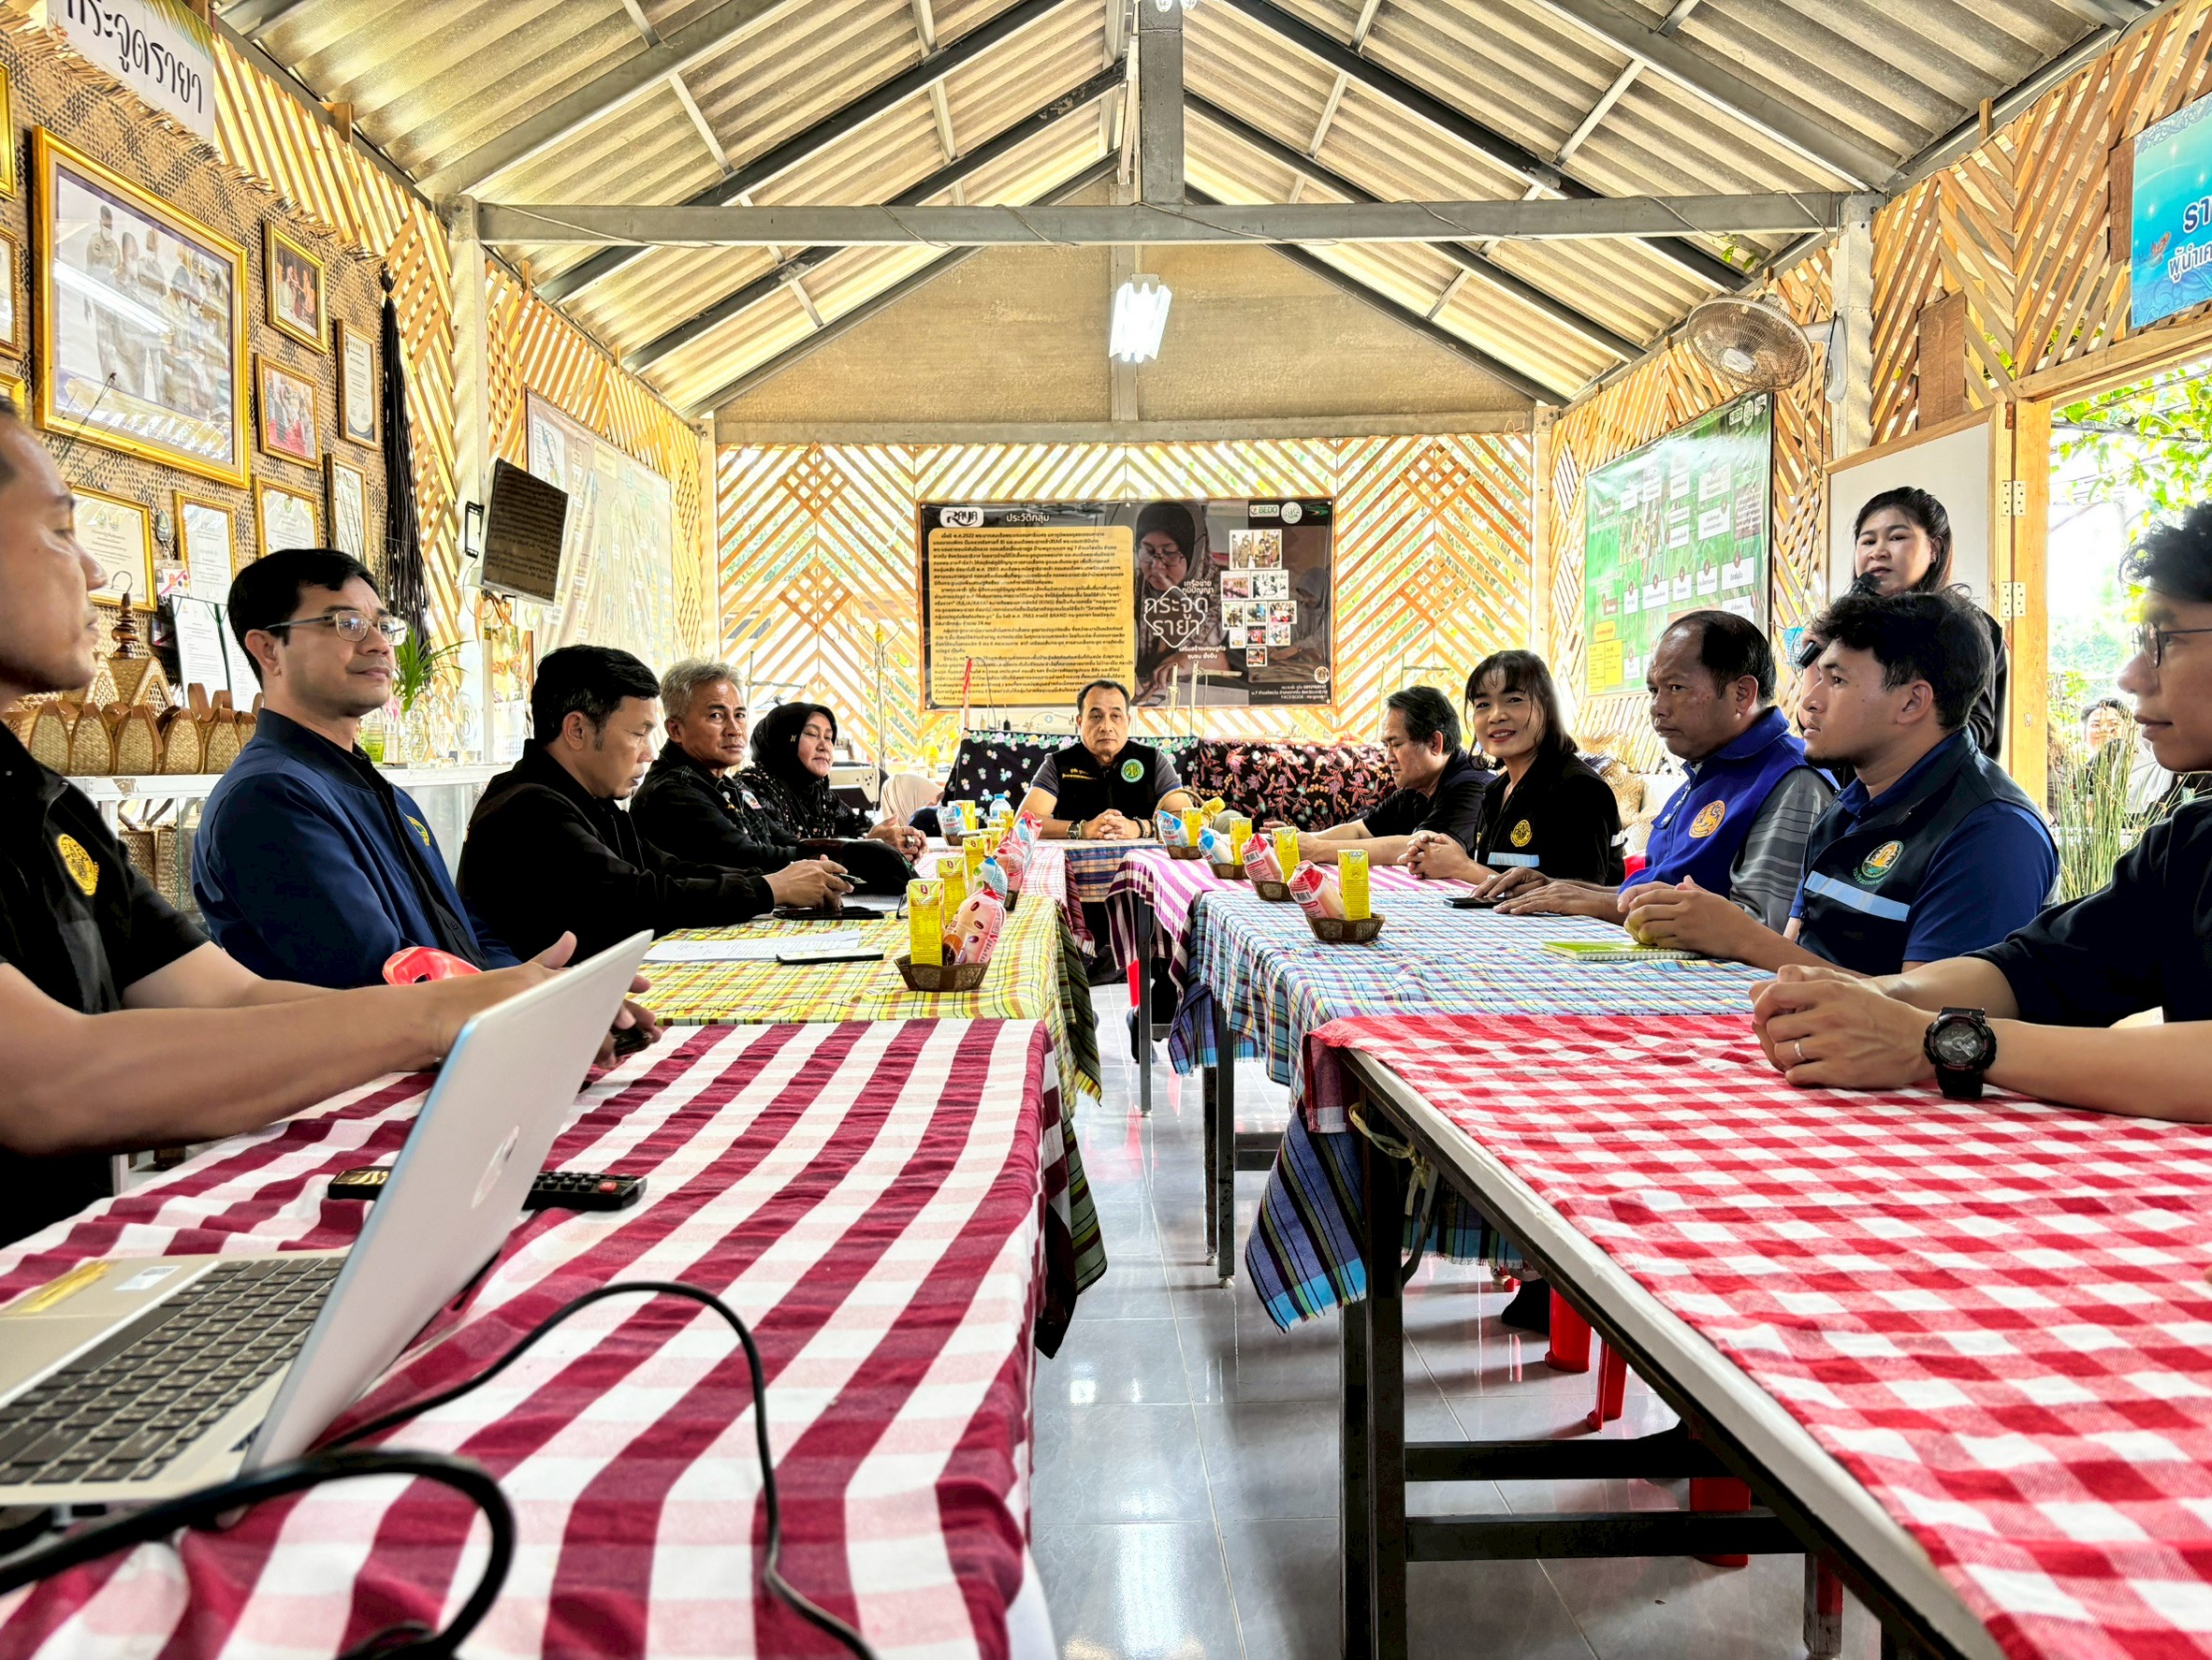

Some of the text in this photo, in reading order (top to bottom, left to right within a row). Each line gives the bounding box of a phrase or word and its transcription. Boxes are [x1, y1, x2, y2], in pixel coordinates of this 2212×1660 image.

[2184, 197, 2212, 231] รา
[946, 510, 978, 526] RAYA
[1006, 512, 1050, 524] ประวัติกลุ่ม
[1143, 597, 1208, 619] กระจูด
[1152, 619, 1201, 636] รายา
